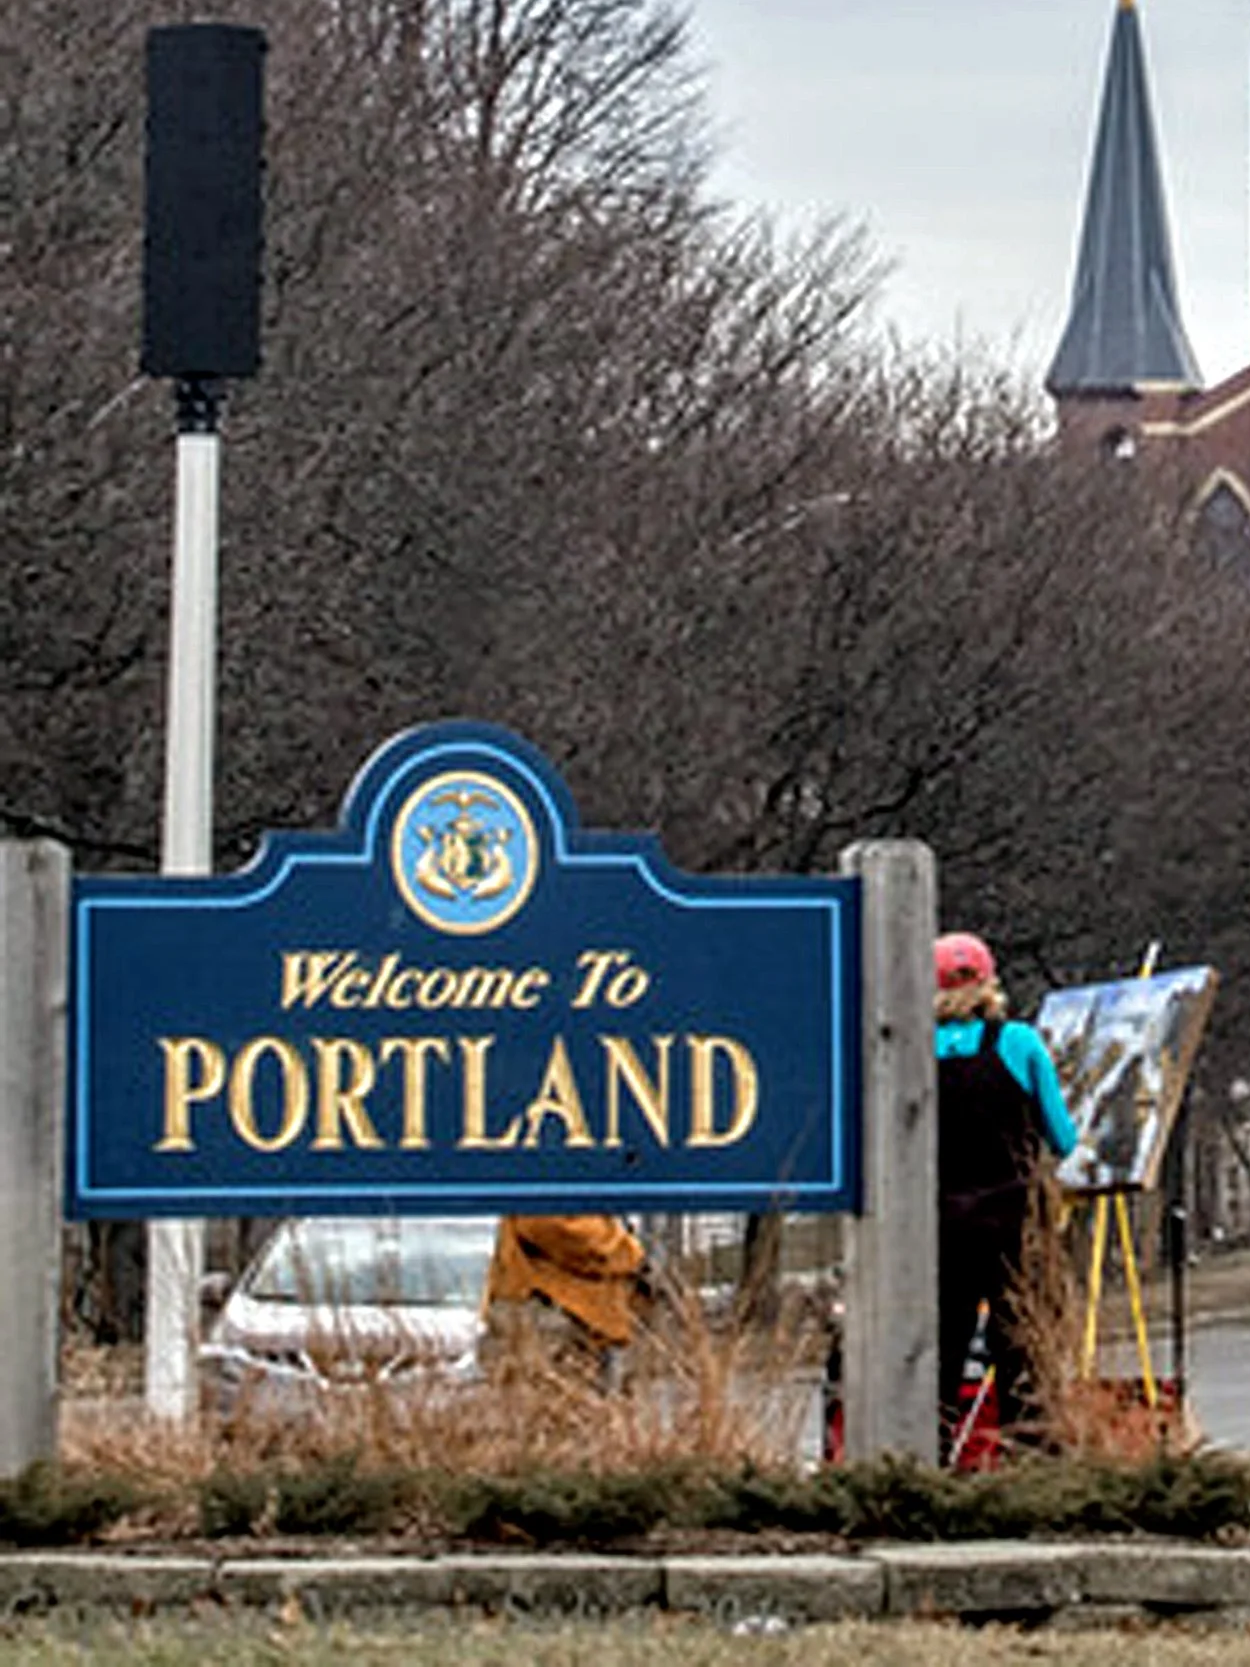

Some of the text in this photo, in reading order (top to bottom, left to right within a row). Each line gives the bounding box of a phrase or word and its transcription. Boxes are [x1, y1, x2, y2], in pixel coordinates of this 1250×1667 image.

[280, 949, 649, 1010] Welcome To
[154, 1034, 760, 1152] PORTLAND
